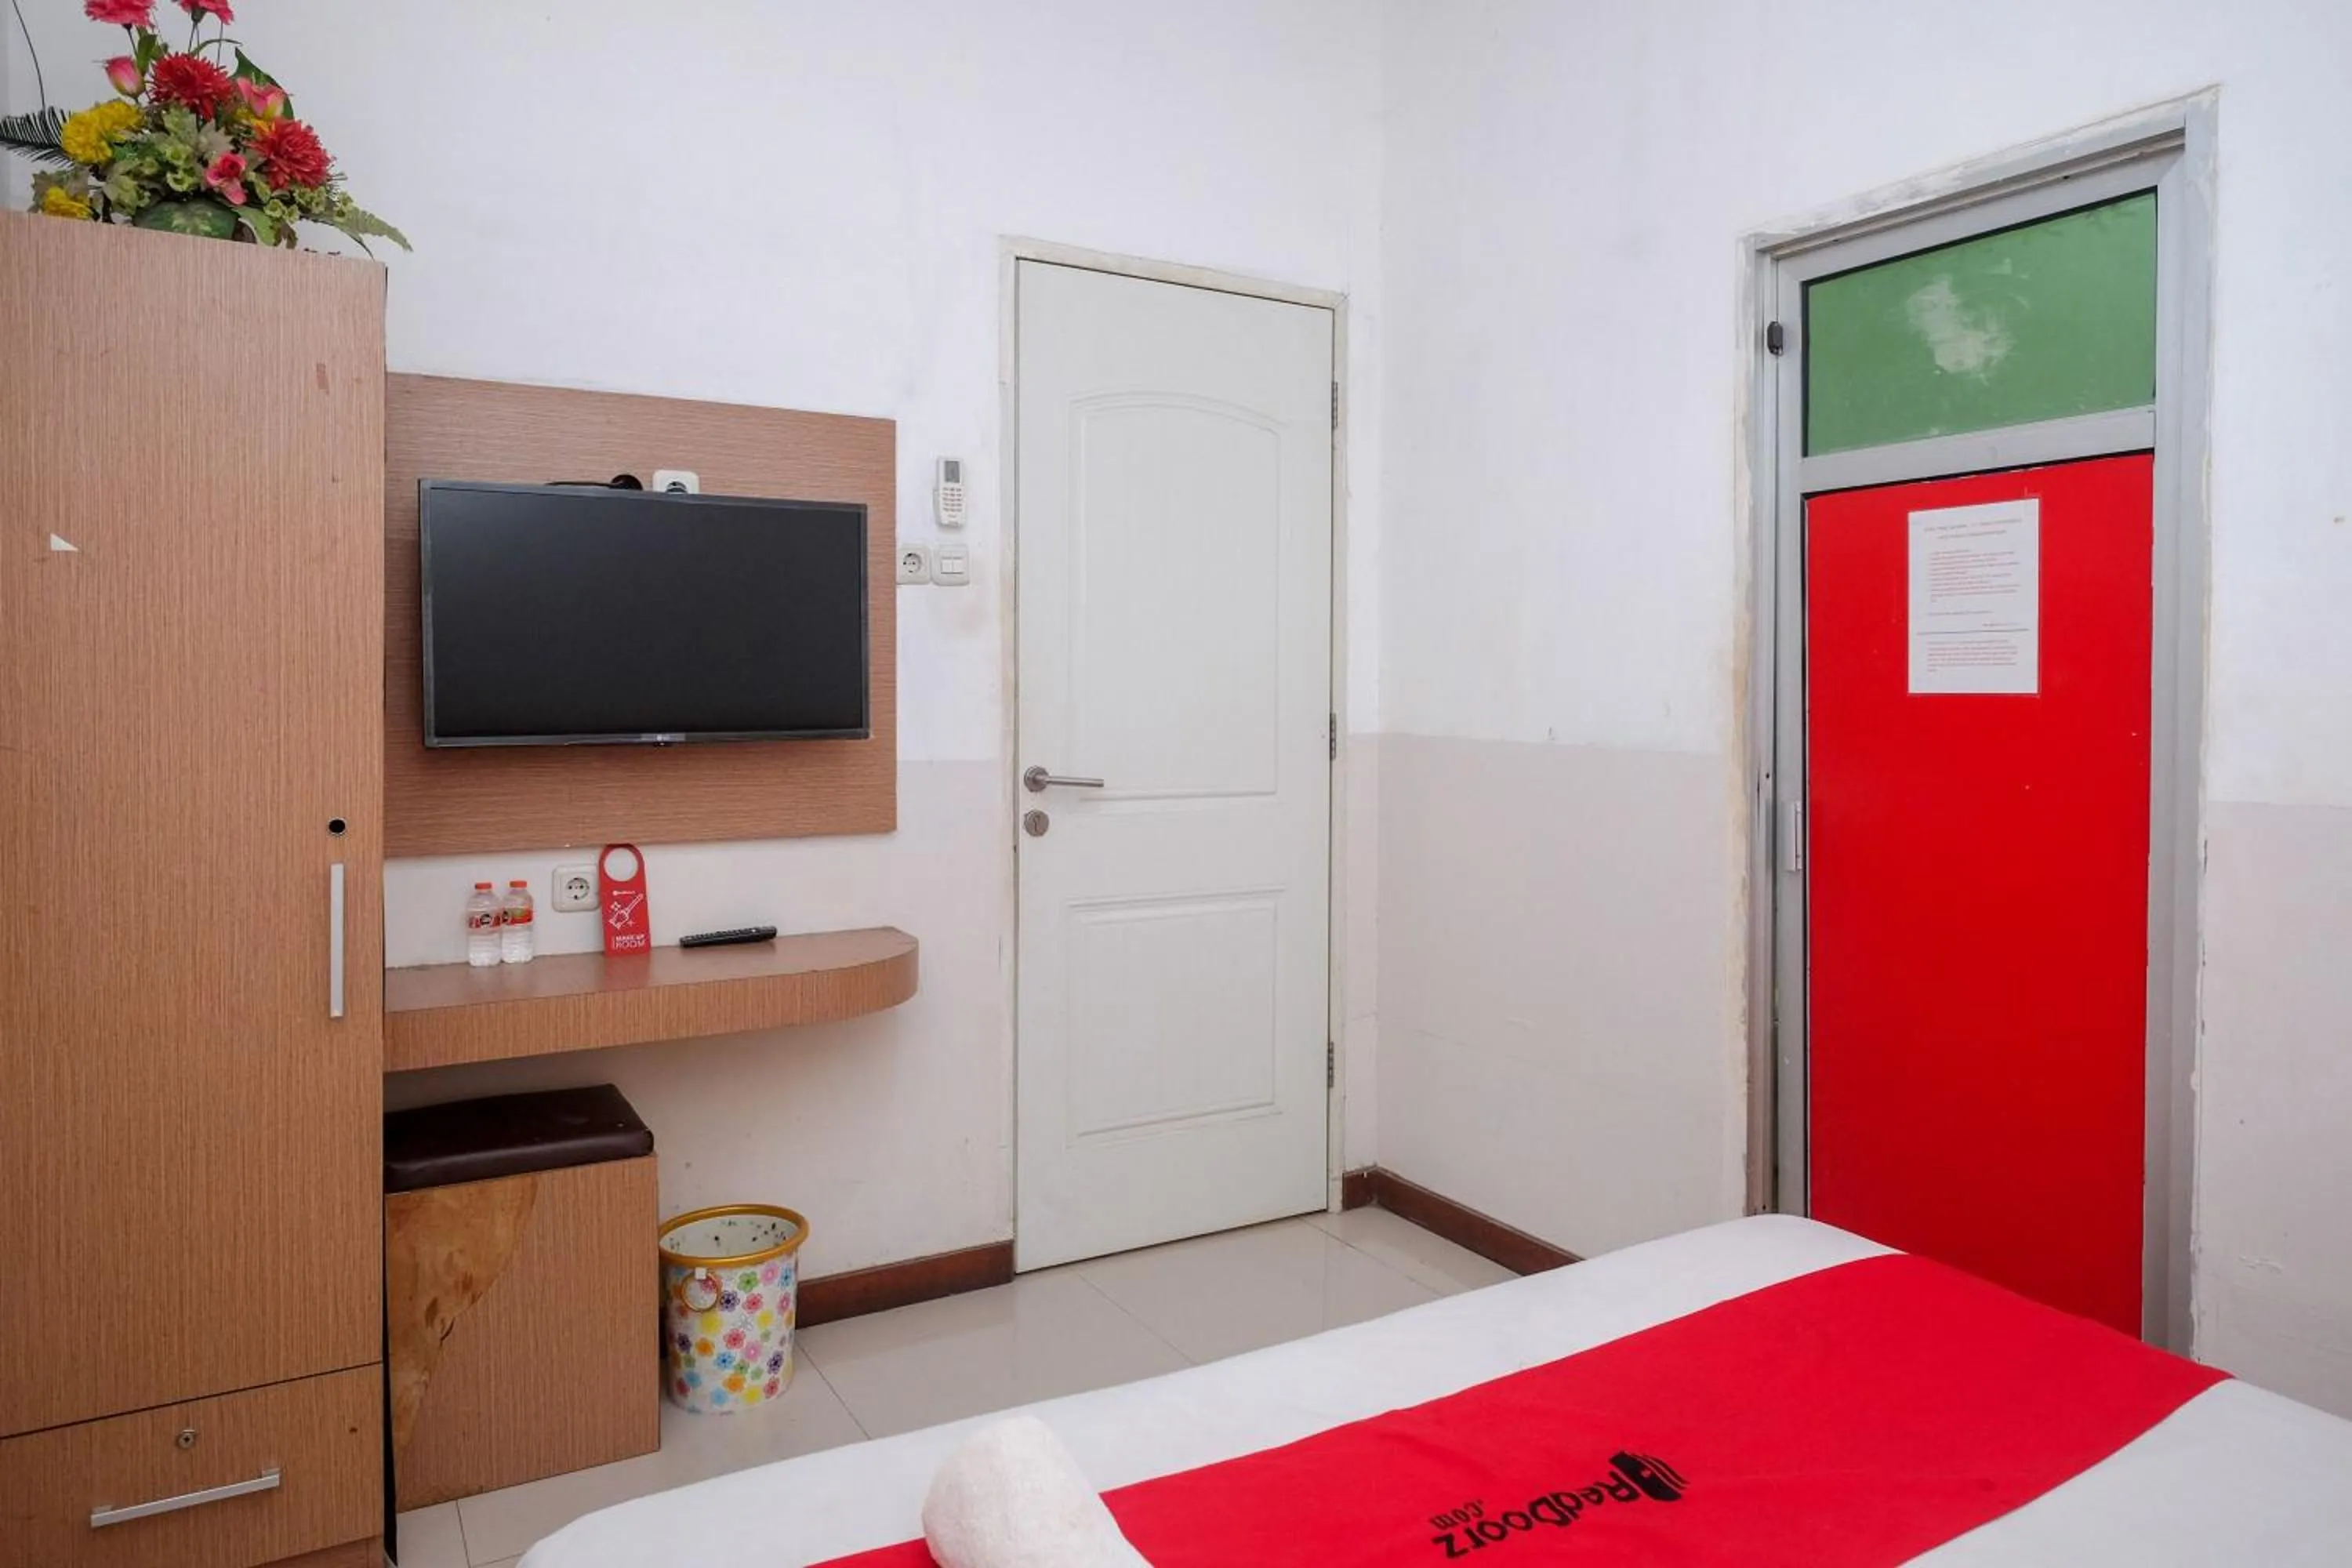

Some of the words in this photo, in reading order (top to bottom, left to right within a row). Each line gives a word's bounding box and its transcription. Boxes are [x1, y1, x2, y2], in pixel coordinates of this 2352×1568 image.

[615, 940, 645, 949] ROOM
[1429, 1499, 1484, 1530] .com
[1432, 1470, 1641, 1559] RedDoorz
